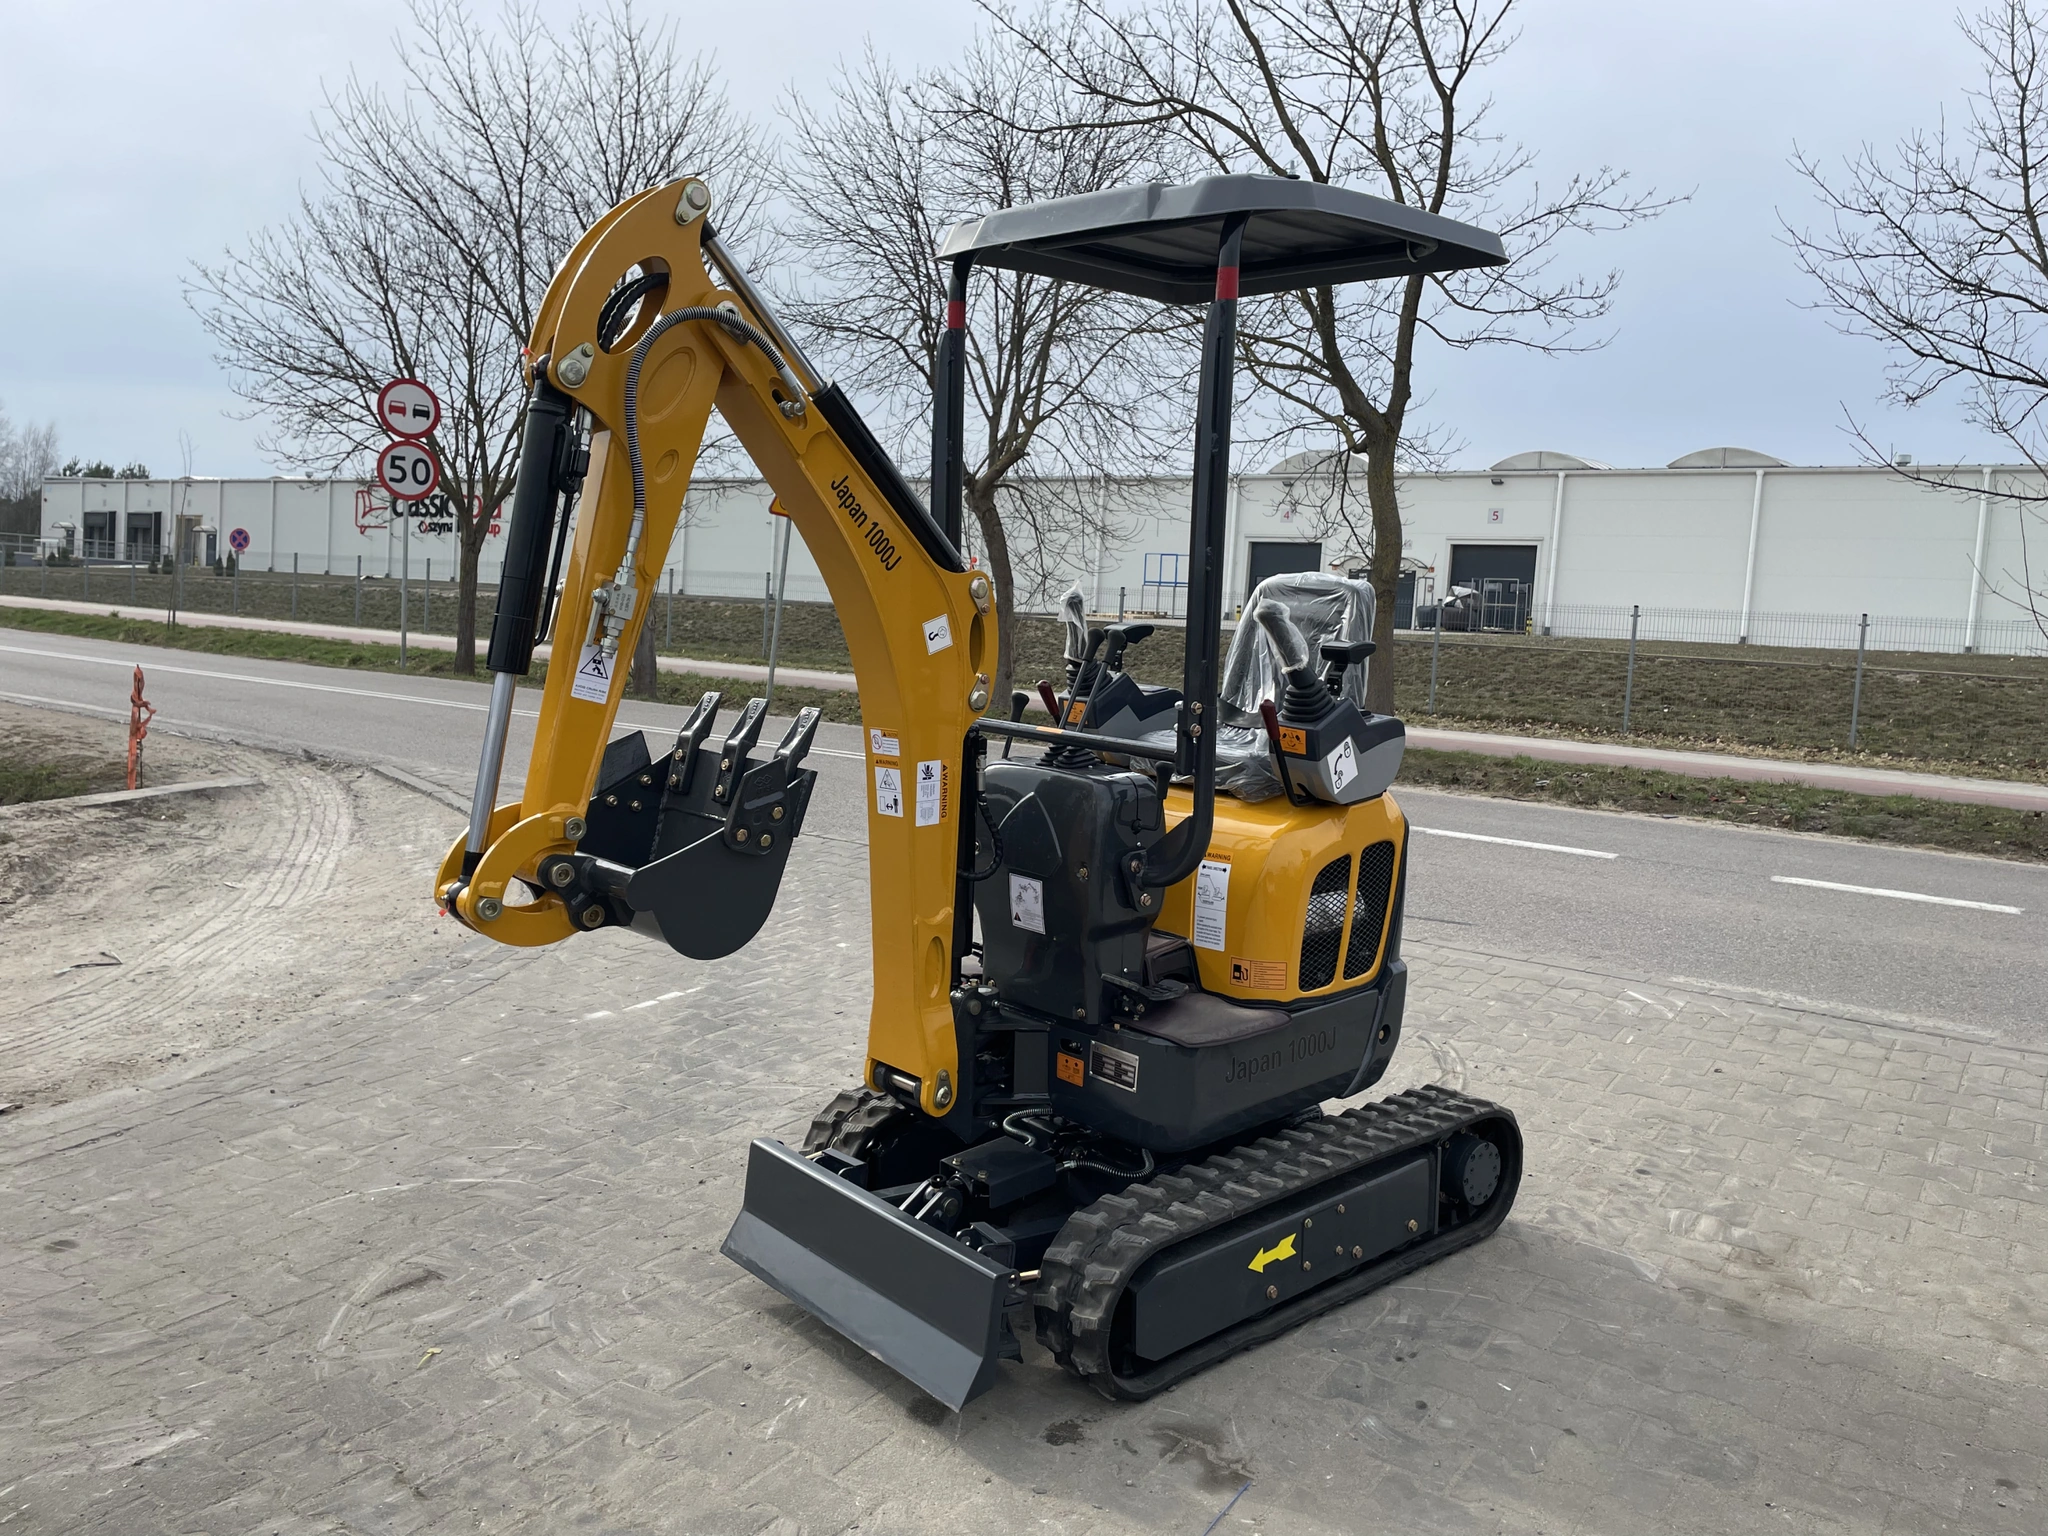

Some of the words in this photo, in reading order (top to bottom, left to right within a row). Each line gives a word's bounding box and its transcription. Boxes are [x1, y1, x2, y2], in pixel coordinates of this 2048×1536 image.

[388, 454, 431, 486] 50
[830, 475, 868, 528] Japan
[864, 521, 902, 572] 1000J
[1492, 510, 1499, 521] 5
[941, 772, 949, 818] WARNING
[1207, 852, 1231, 861] WARNING
[1225, 1056, 1282, 1083] Japan
[1288, 1026, 1337, 1063] 1000J
